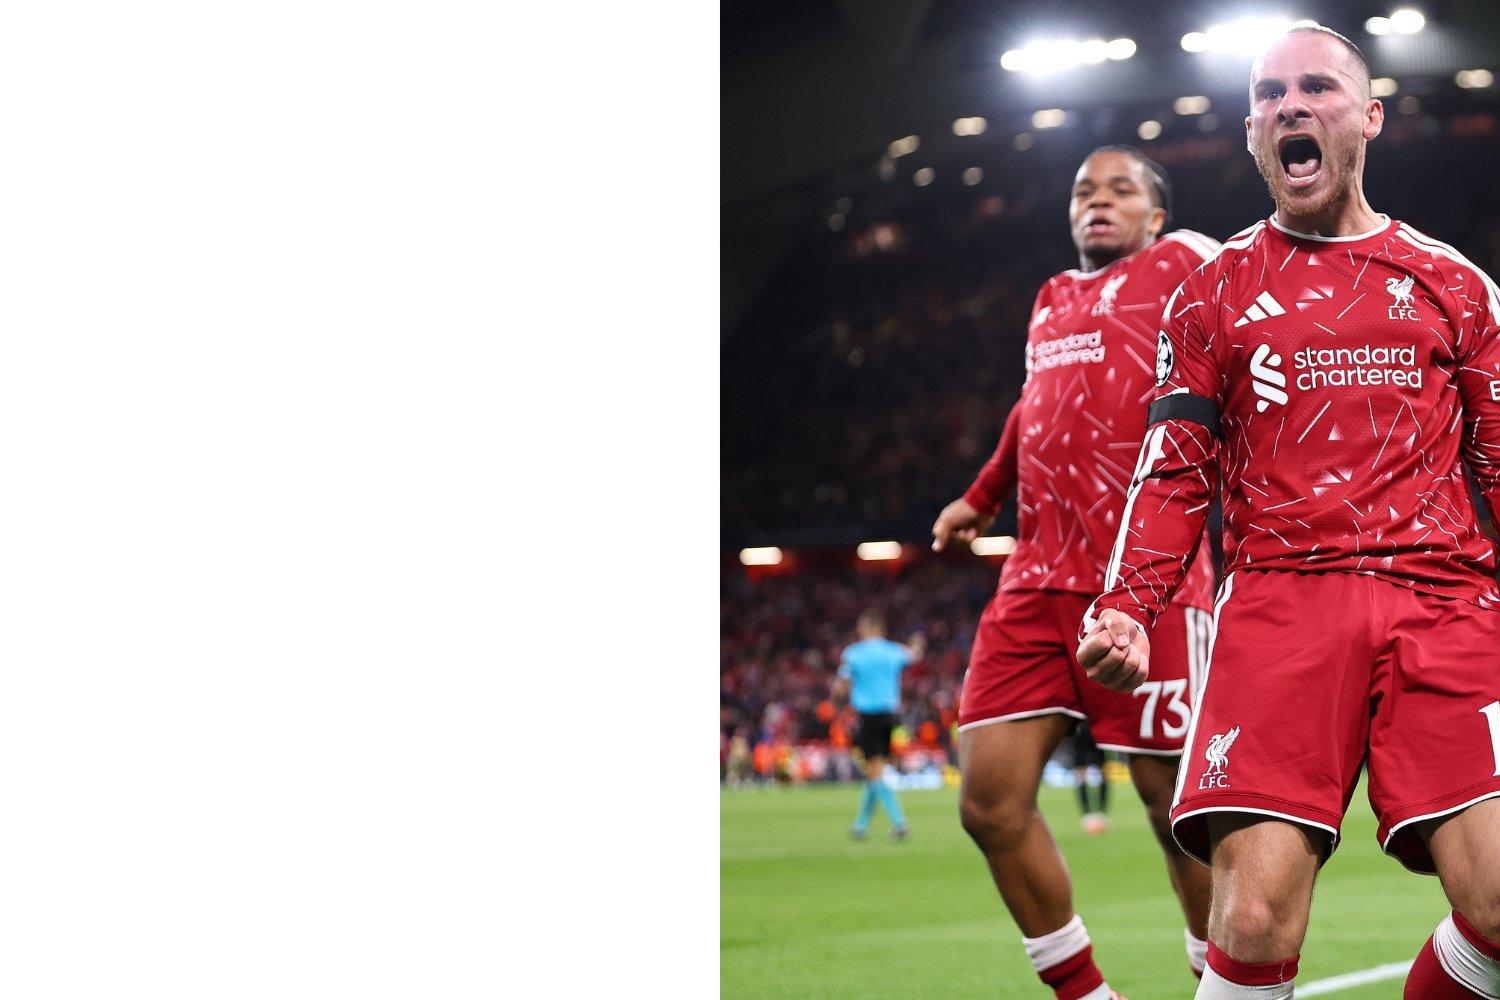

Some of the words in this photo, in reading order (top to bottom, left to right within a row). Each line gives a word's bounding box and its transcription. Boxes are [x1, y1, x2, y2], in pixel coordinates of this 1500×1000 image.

[1034, 329, 1102, 359] standard
[1294, 344, 1416, 369] standard
[1033, 345, 1106, 373] chartered
[1296, 365, 1422, 391] chartered
[1132, 678, 1192, 739] 73
[1198, 774, 1231, 790] L.F.C.
